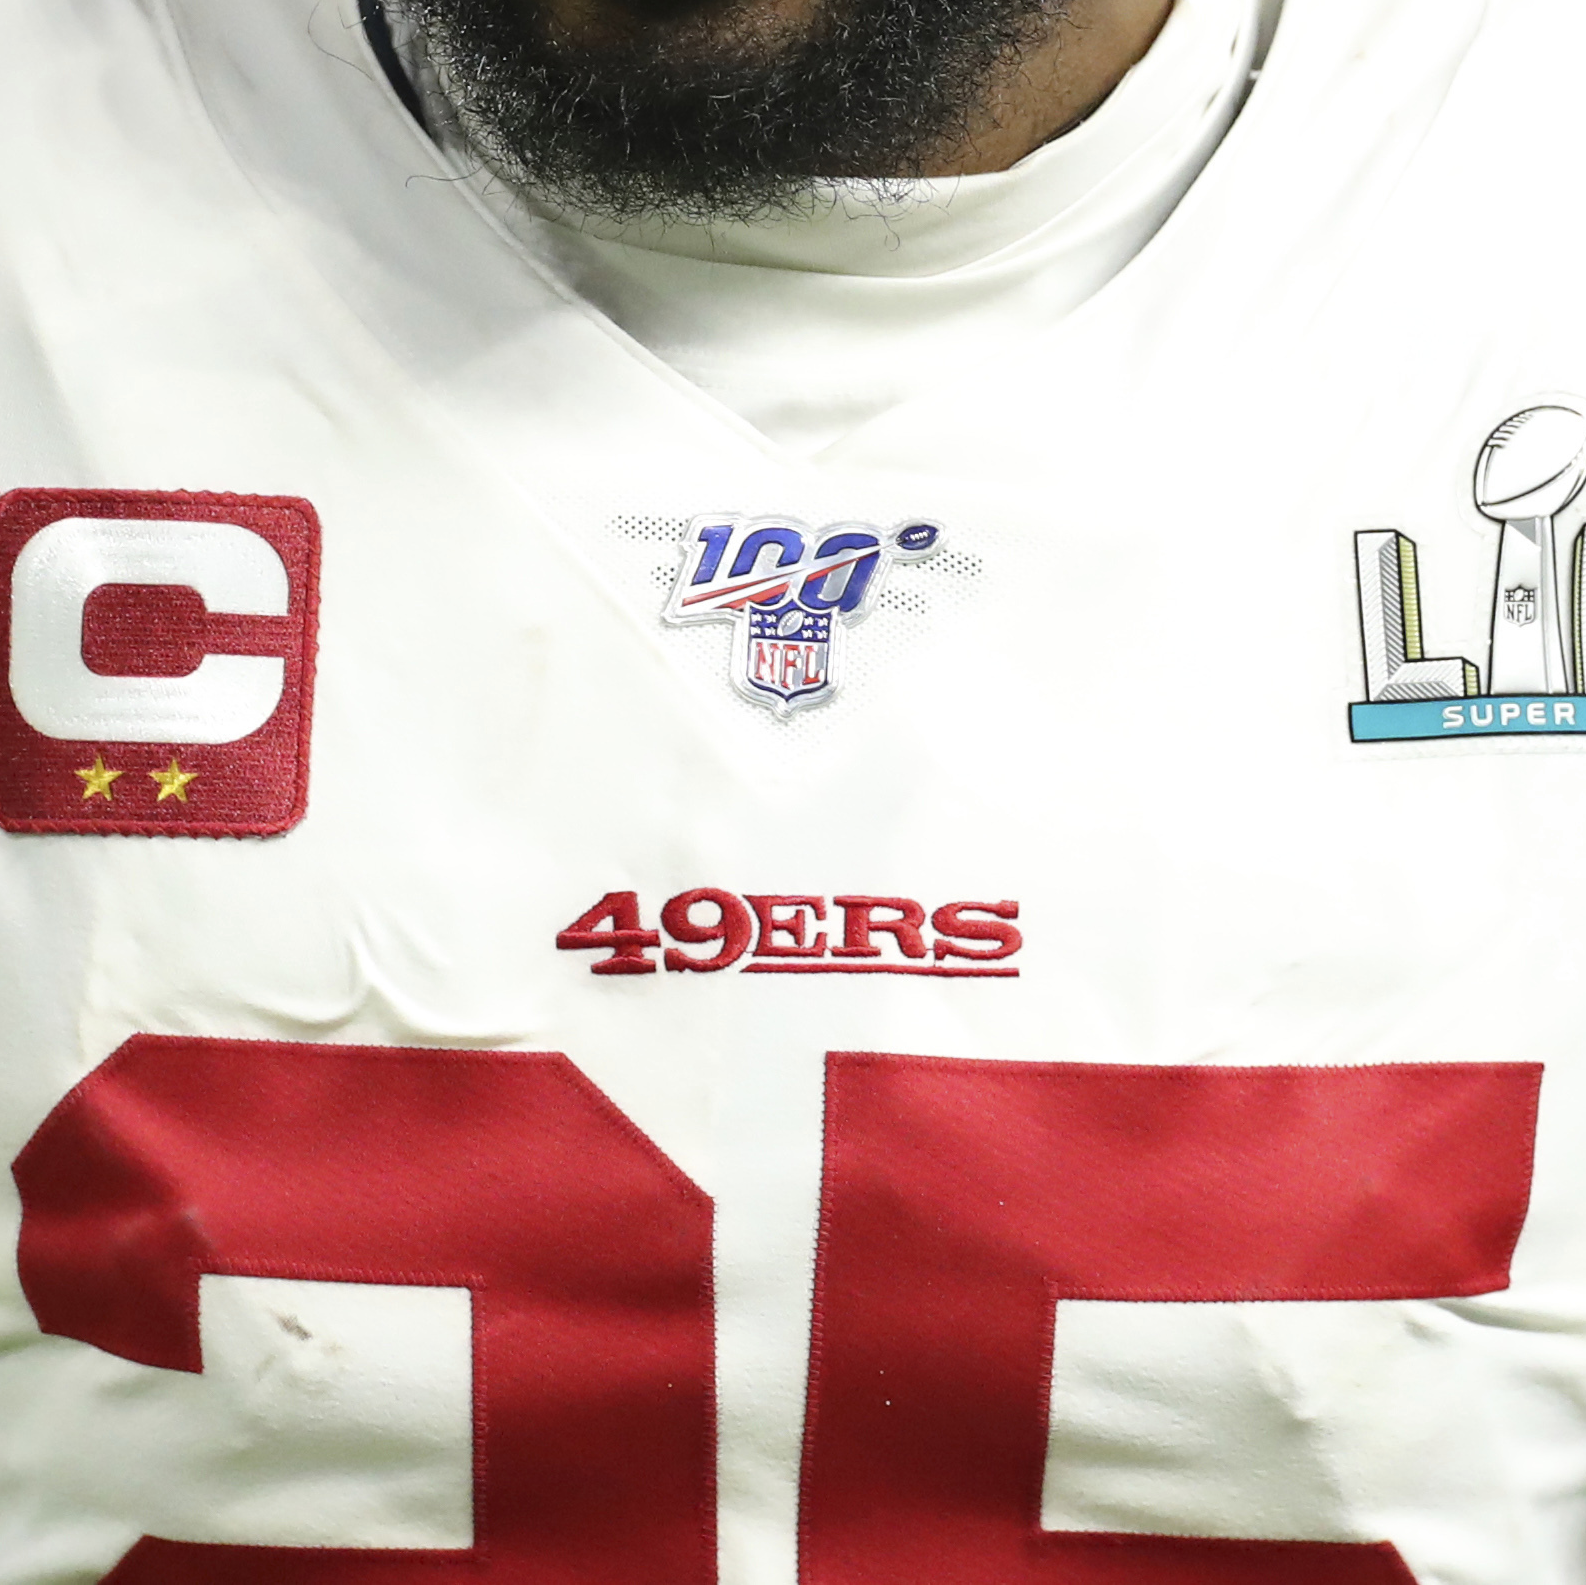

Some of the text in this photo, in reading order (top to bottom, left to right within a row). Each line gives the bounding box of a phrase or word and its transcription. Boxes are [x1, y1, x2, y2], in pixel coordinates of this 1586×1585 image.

[685, 525, 880, 613] 100
[8, 517, 290, 745] C
[1506, 603, 1533, 623] NFL
[755, 642, 826, 690] NFL
[1442, 702, 1576, 729] SUPER
[555, 887, 1023, 975] 49ERS
